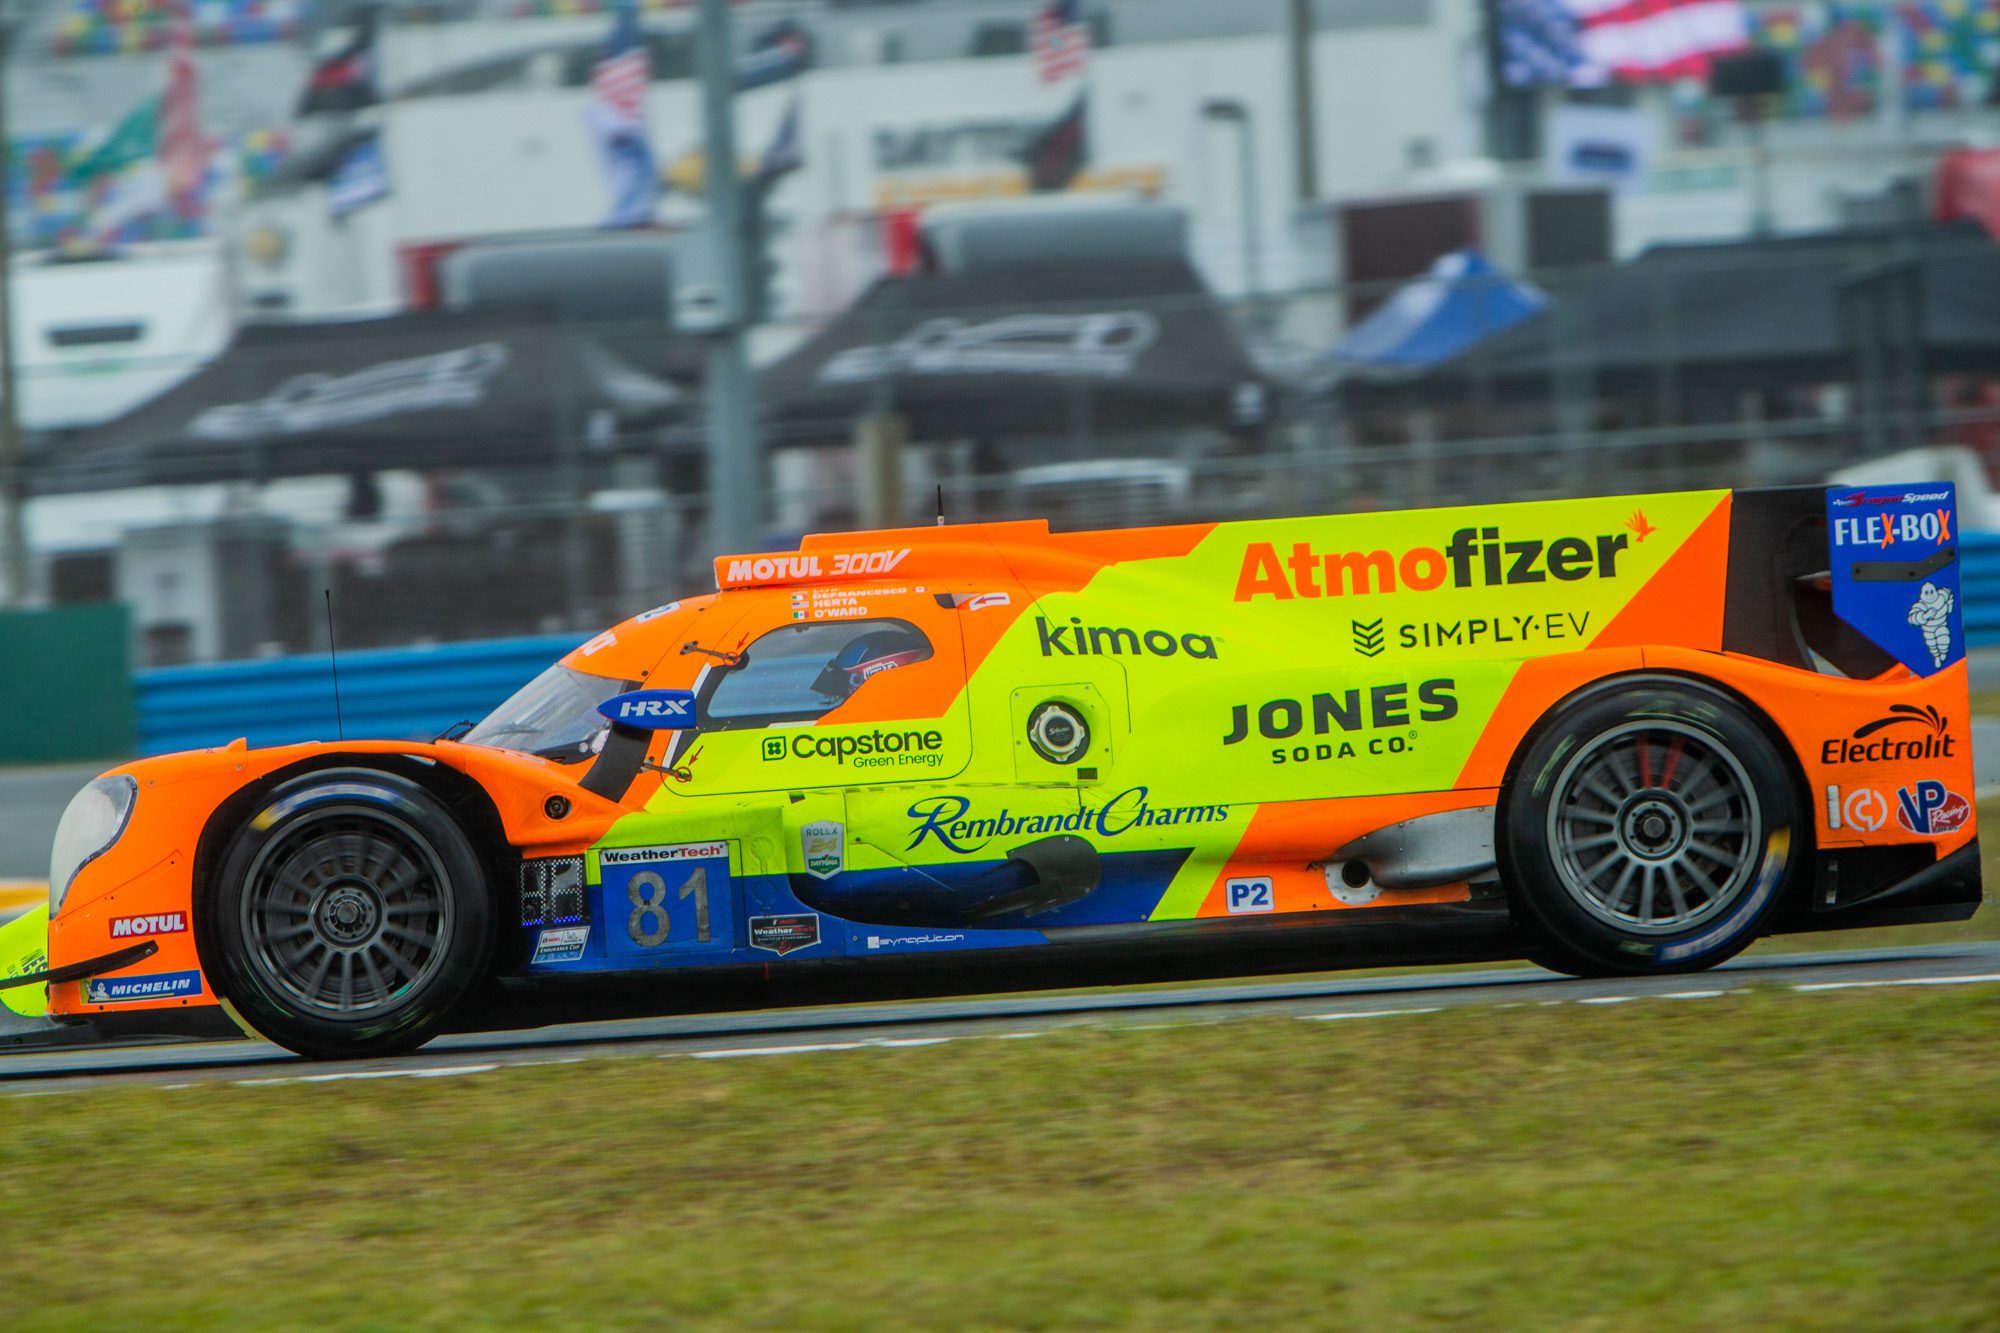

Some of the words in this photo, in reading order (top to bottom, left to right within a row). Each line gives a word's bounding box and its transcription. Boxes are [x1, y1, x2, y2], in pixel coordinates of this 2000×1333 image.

[727, 556, 823, 582] MOTUL
[830, 548, 912, 575] 300V
[1233, 526, 1628, 602] Atmofizer
[813, 598, 858, 608] HERTA
[814, 606, 868, 618] O'WARD
[1035, 616, 1219, 659] kimoa
[620, 699, 691, 717] HRX
[1223, 678, 1459, 746] JONES
[792, 730, 943, 765] Capstone
[1272, 743, 1356, 764] SODA
[1821, 734, 1955, 764] Electrolit
[853, 757, 895, 768] Green
[899, 753, 944, 767] Energy
[1896, 781, 1946, 834] VP
[604, 846, 724, 862] WeatherTech
[627, 867, 712, 947] 81
[1231, 884, 1268, 907] P2
[112, 914, 184, 936] MOTUL
[111, 979, 190, 995] MICHELIN
